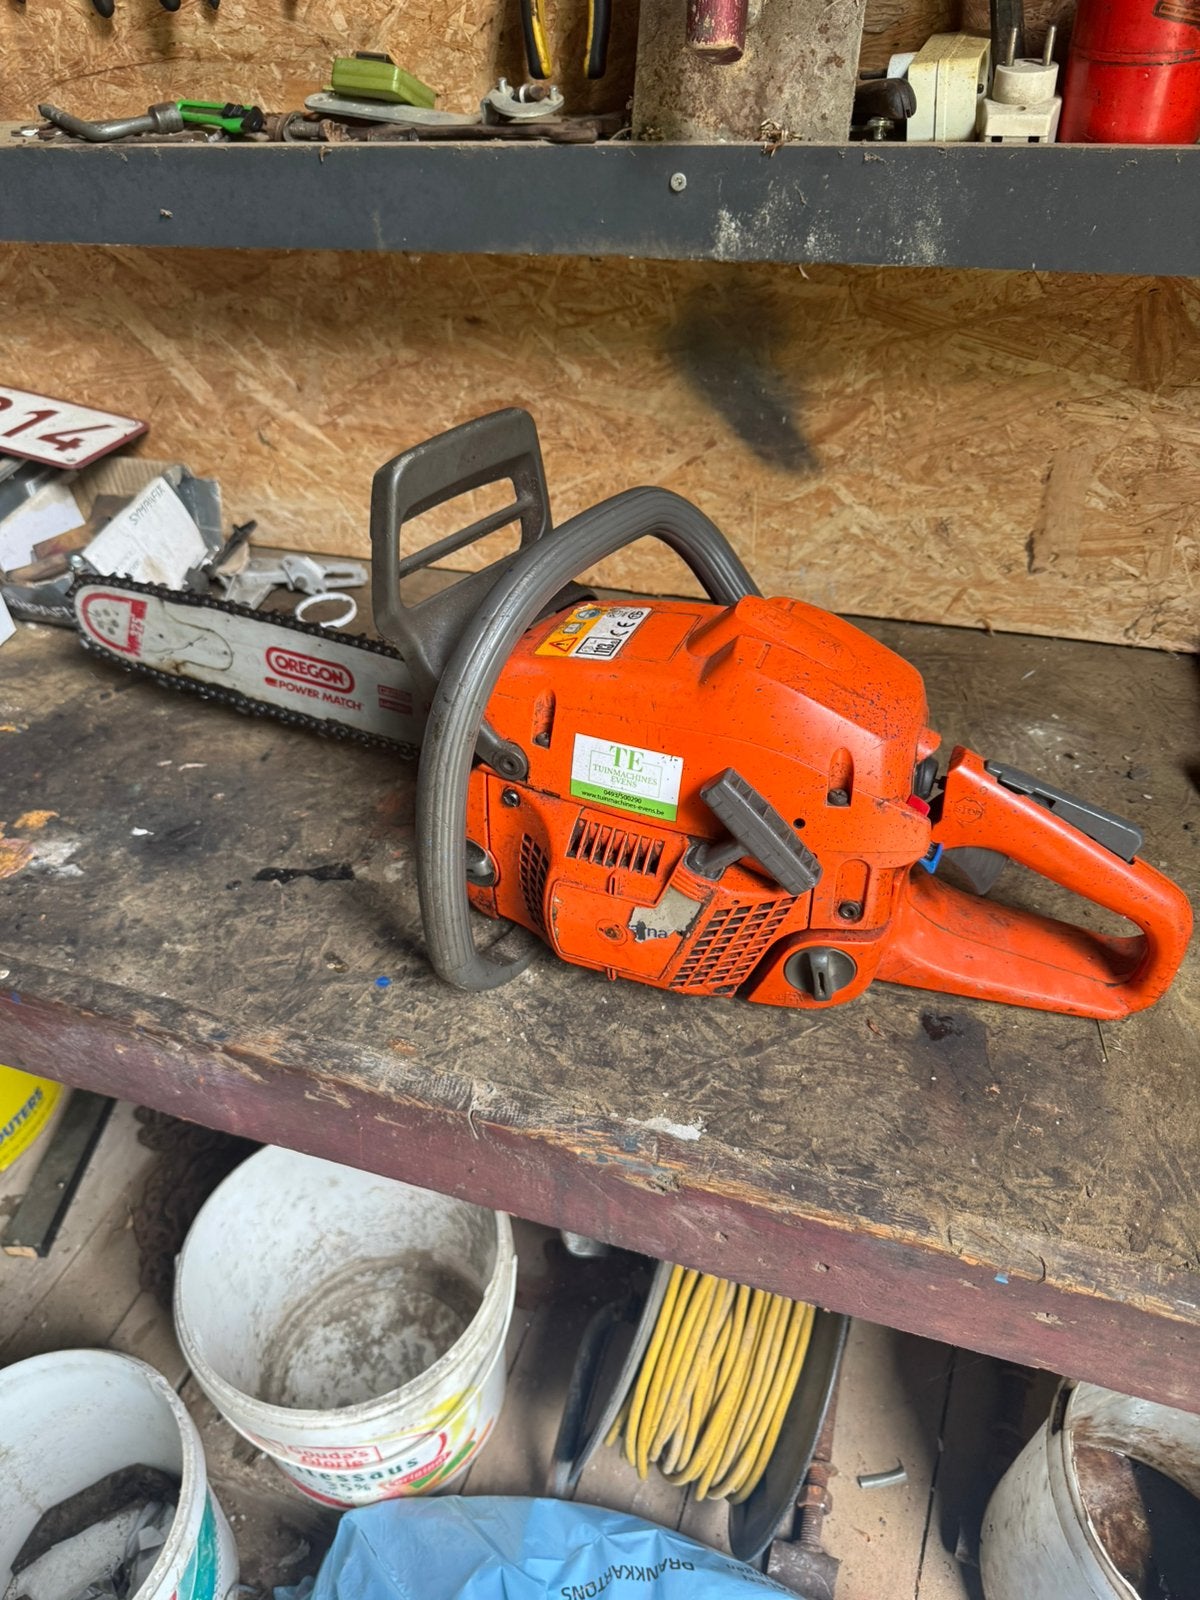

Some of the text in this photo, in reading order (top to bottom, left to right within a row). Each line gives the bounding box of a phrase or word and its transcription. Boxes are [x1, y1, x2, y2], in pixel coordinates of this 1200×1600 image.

[275, 655, 345, 686] OREGON
[279, 680, 321, 699] POWER
[322, 693, 362, 711] MATCH
[609, 745, 644, 773] TE
[593, 763, 658, 786] TUINMACHINES
[611, 776, 637, 788] EVENS
[581, 790, 665, 816] www.tuinmachines-evens.be
